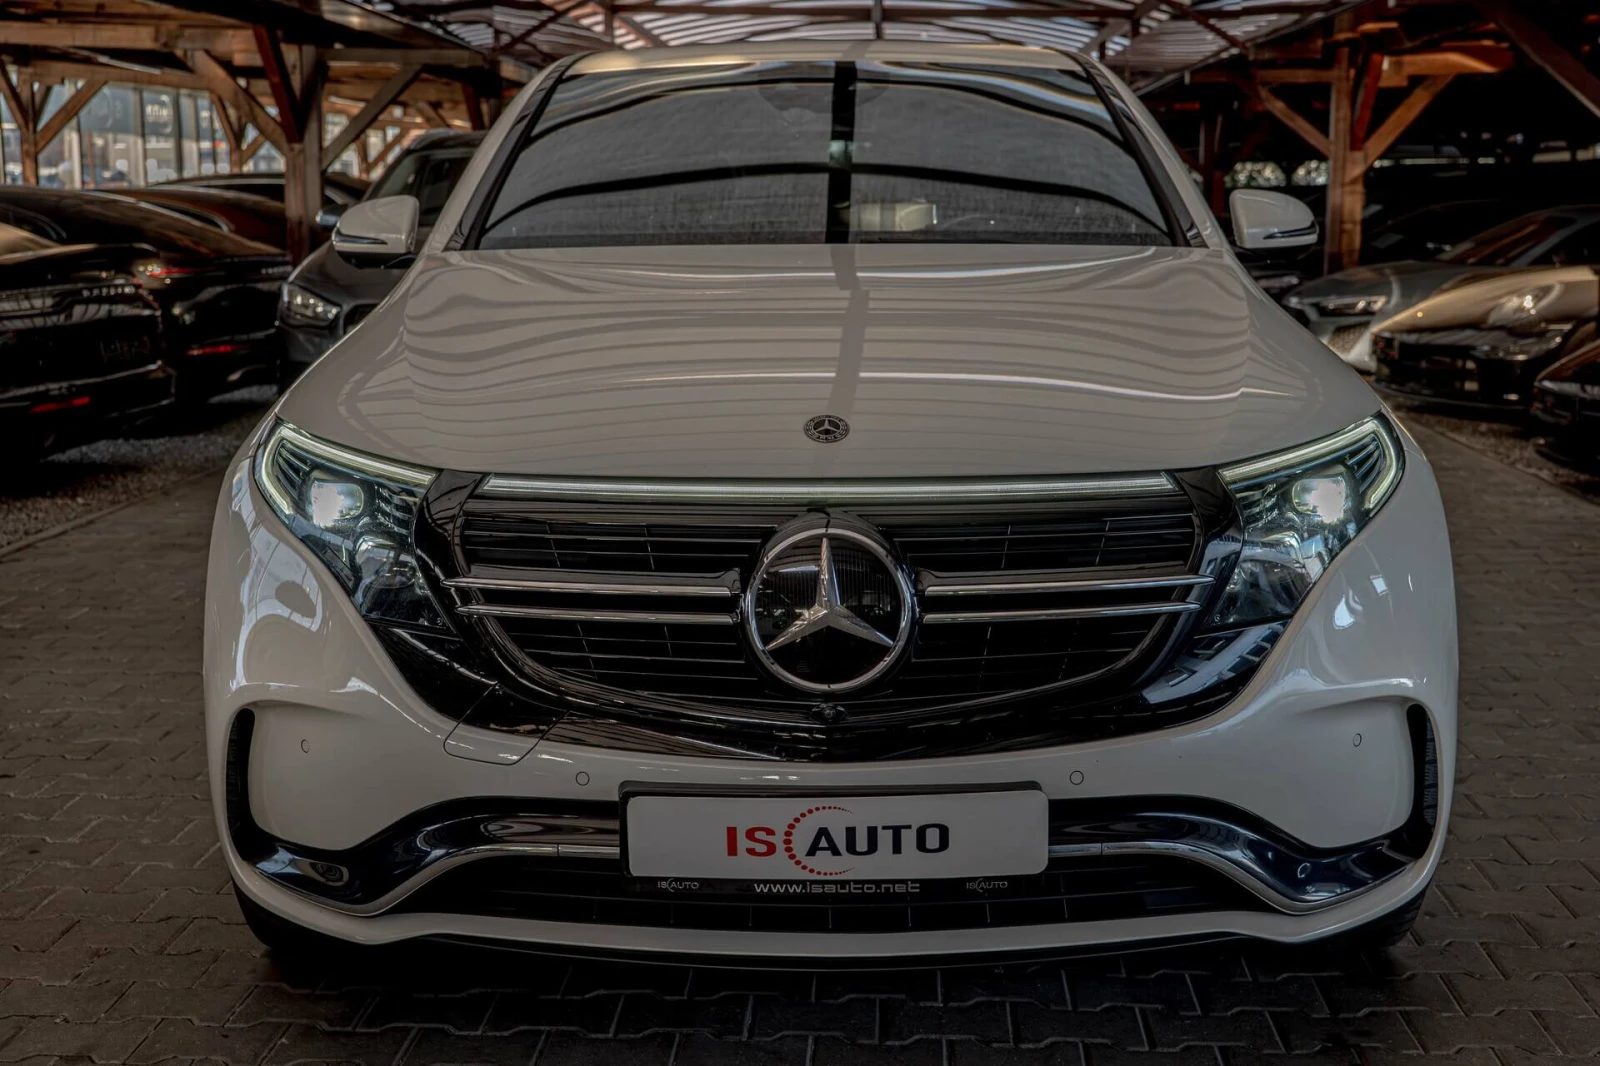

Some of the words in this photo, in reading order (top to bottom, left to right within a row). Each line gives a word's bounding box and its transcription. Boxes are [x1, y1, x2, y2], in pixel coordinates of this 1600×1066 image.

[726, 826, 777, 857] IS
[804, 823, 950, 857] AUTO
[754, 881, 920, 893] www.isauto.net
